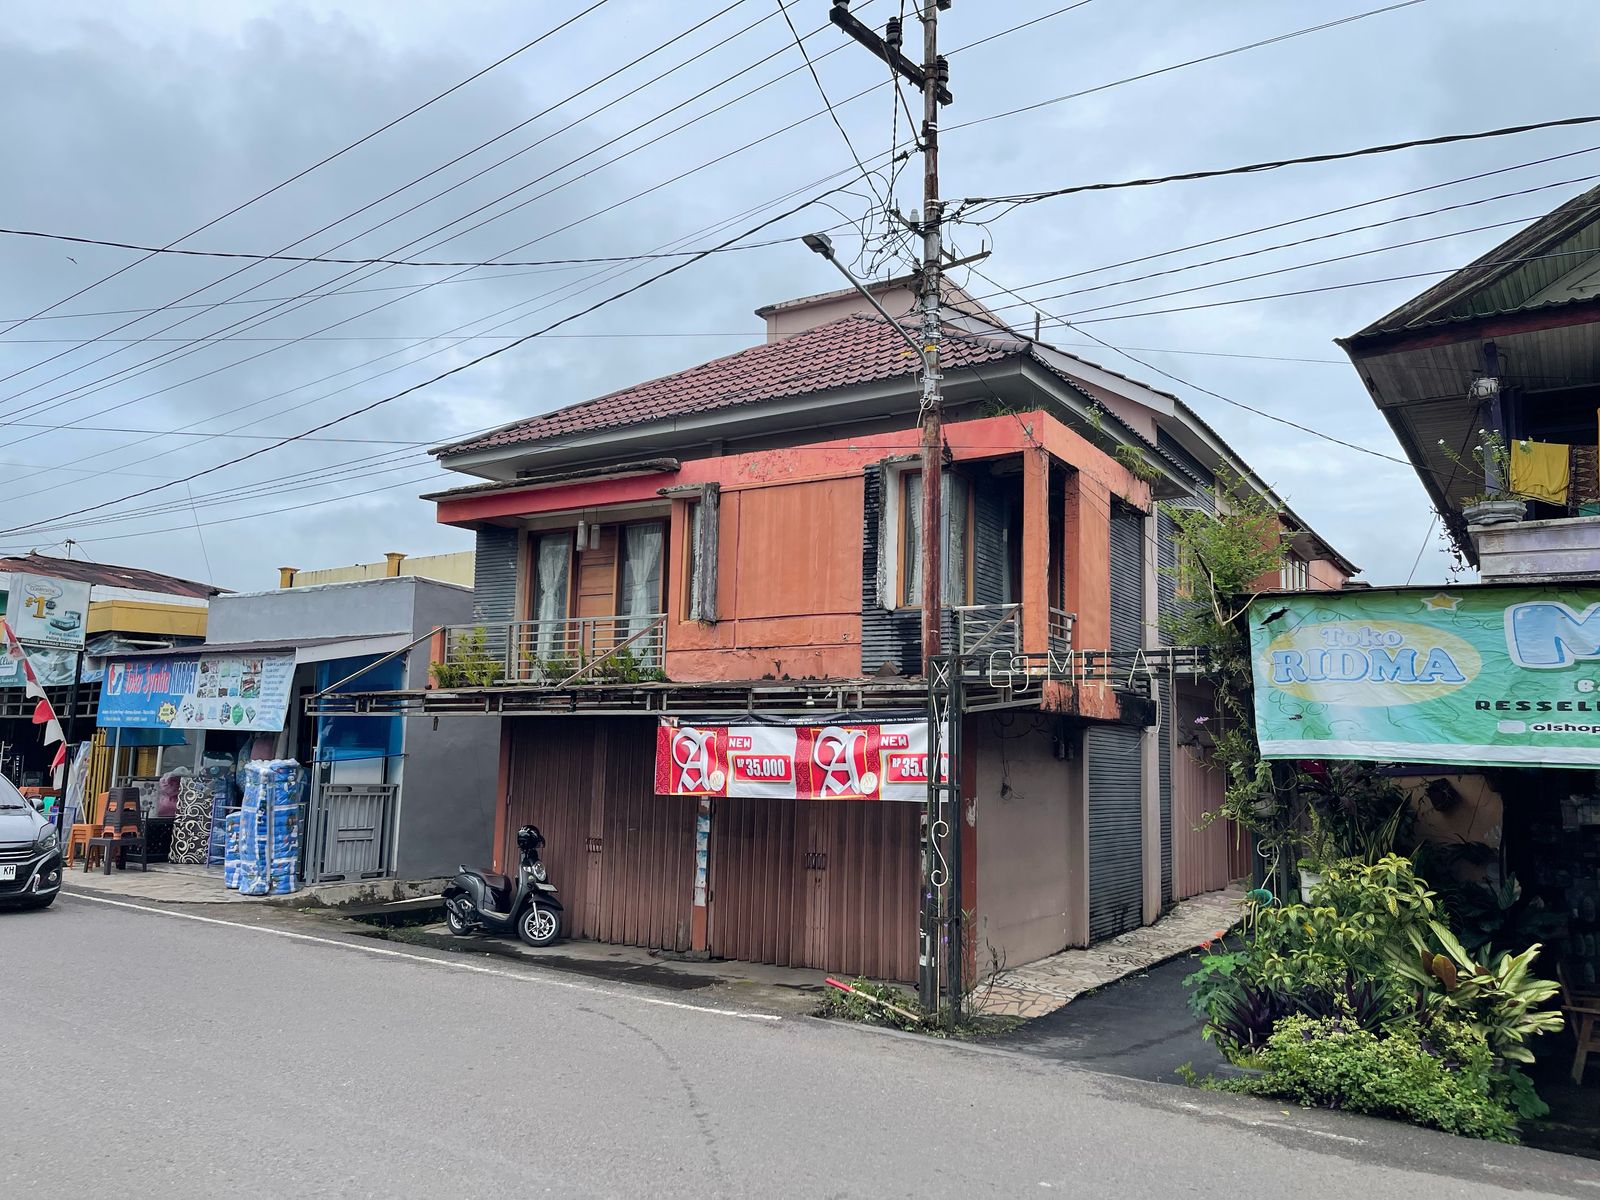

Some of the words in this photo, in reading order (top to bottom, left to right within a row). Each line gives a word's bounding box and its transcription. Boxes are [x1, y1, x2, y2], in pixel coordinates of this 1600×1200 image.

[1319, 626, 1404, 649] Toko
[1271, 646, 1468, 685] RIDMA
[1475, 700, 1600, 712] RESSEL
[728, 738, 750, 748] NEW
[880, 736, 907, 747] NEW
[4, 866, 14, 875] KH
